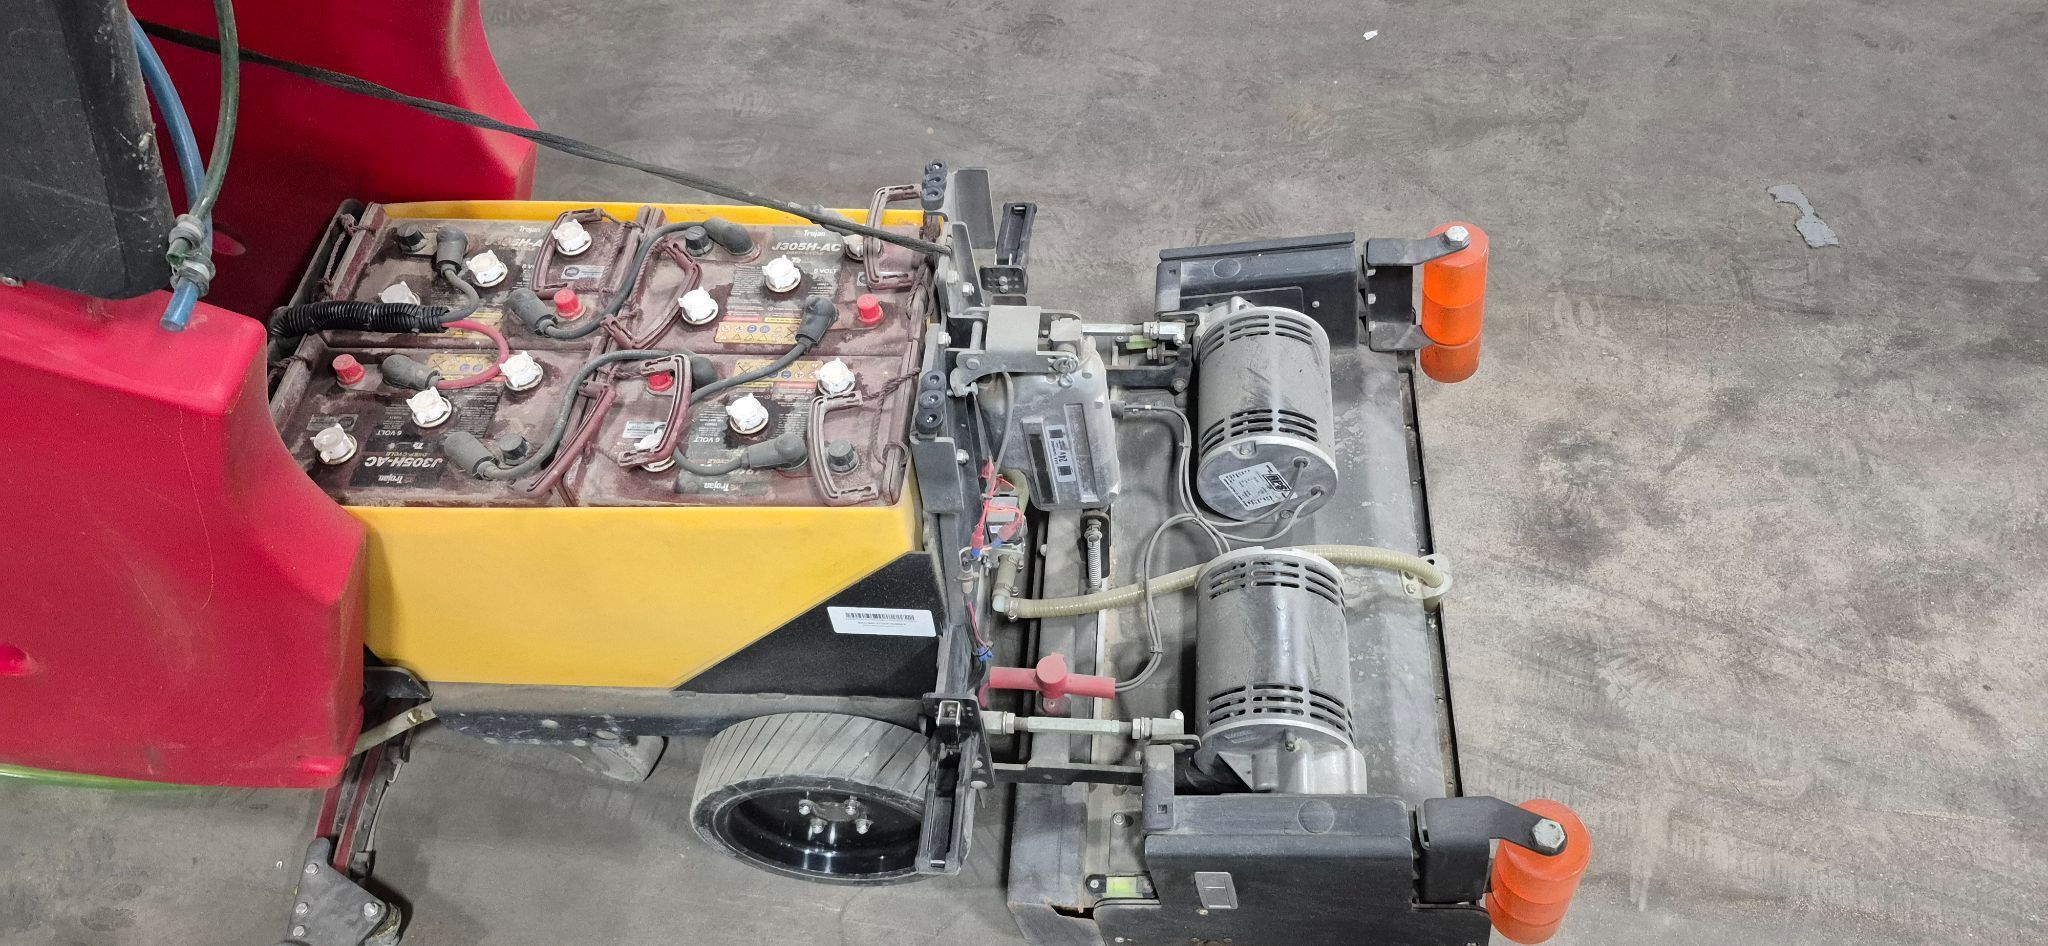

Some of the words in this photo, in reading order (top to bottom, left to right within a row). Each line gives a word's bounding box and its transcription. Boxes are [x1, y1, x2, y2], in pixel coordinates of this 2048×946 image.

[804, 230, 826, 238] Trojan
[772, 242, 841, 252] J305H-AC
[365, 456, 444, 468] J305H-AC
[378, 474, 404, 484] Trojan
[704, 481, 730, 491] Trojan
